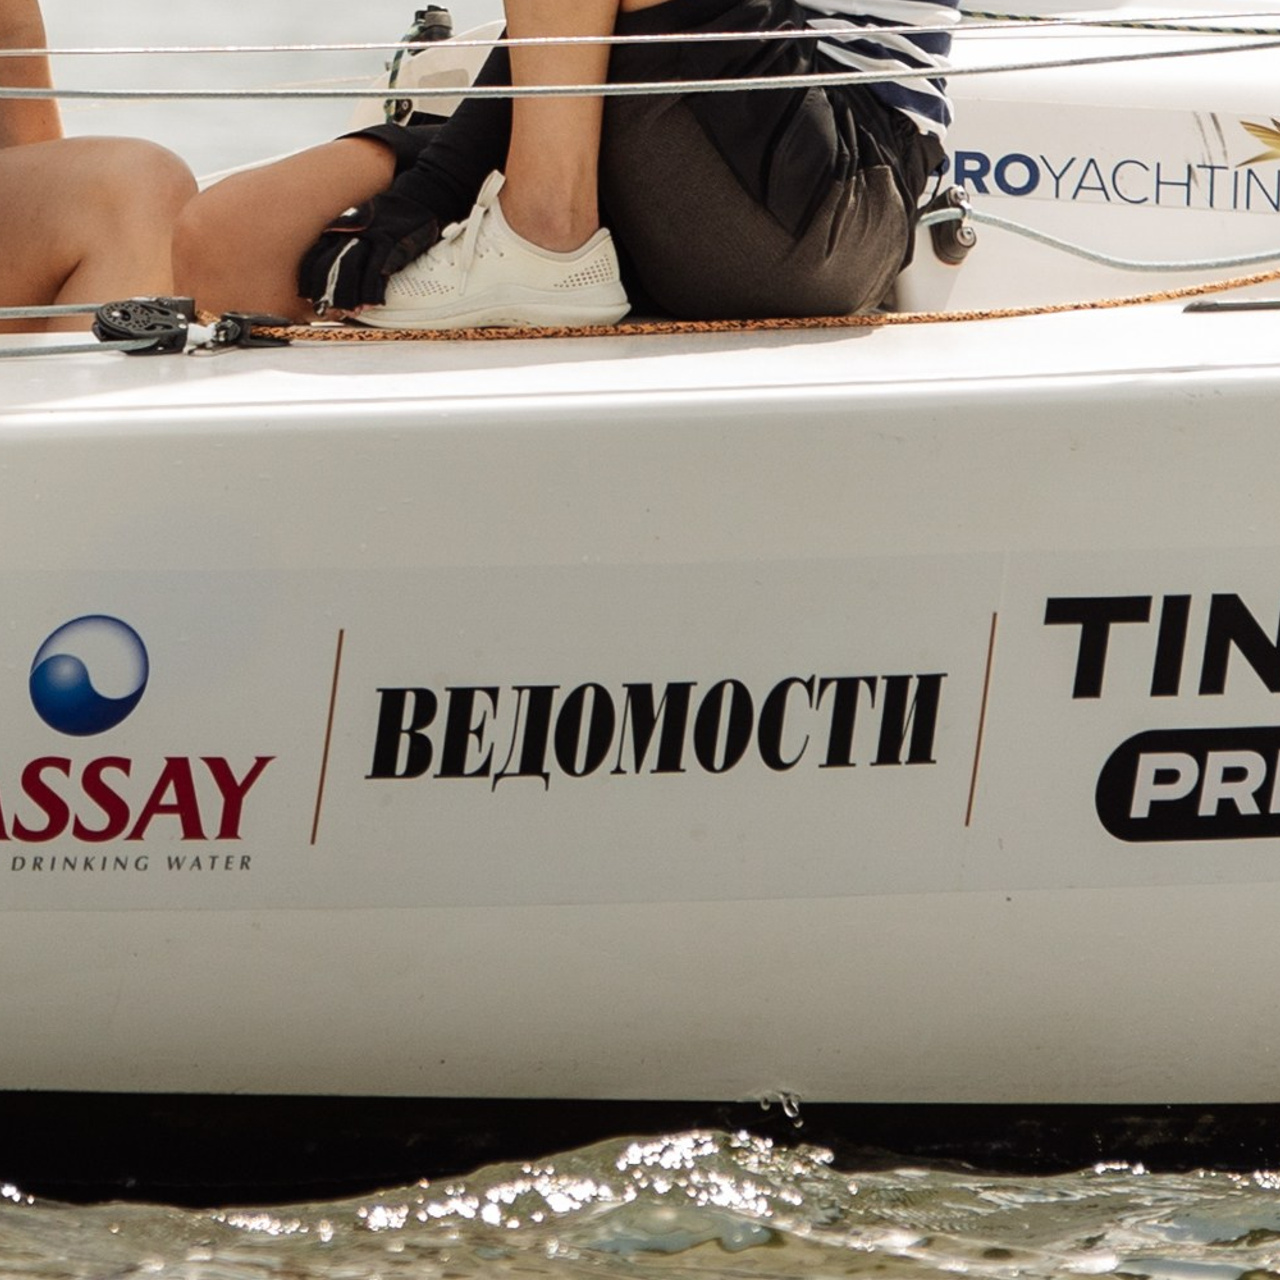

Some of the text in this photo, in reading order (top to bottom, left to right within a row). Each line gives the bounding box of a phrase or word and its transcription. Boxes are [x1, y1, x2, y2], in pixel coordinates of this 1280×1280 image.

[928, 150, 1280, 212] ROYACHTIN
[1043, 593, 1280, 699] TIN
[364, 673, 948, 792] ВЕДОМОСТИ
[1129, 749, 1280, 819] PR
[10, 856, 149, 872] DRINKING
[167, 855, 252, 872] WATER
